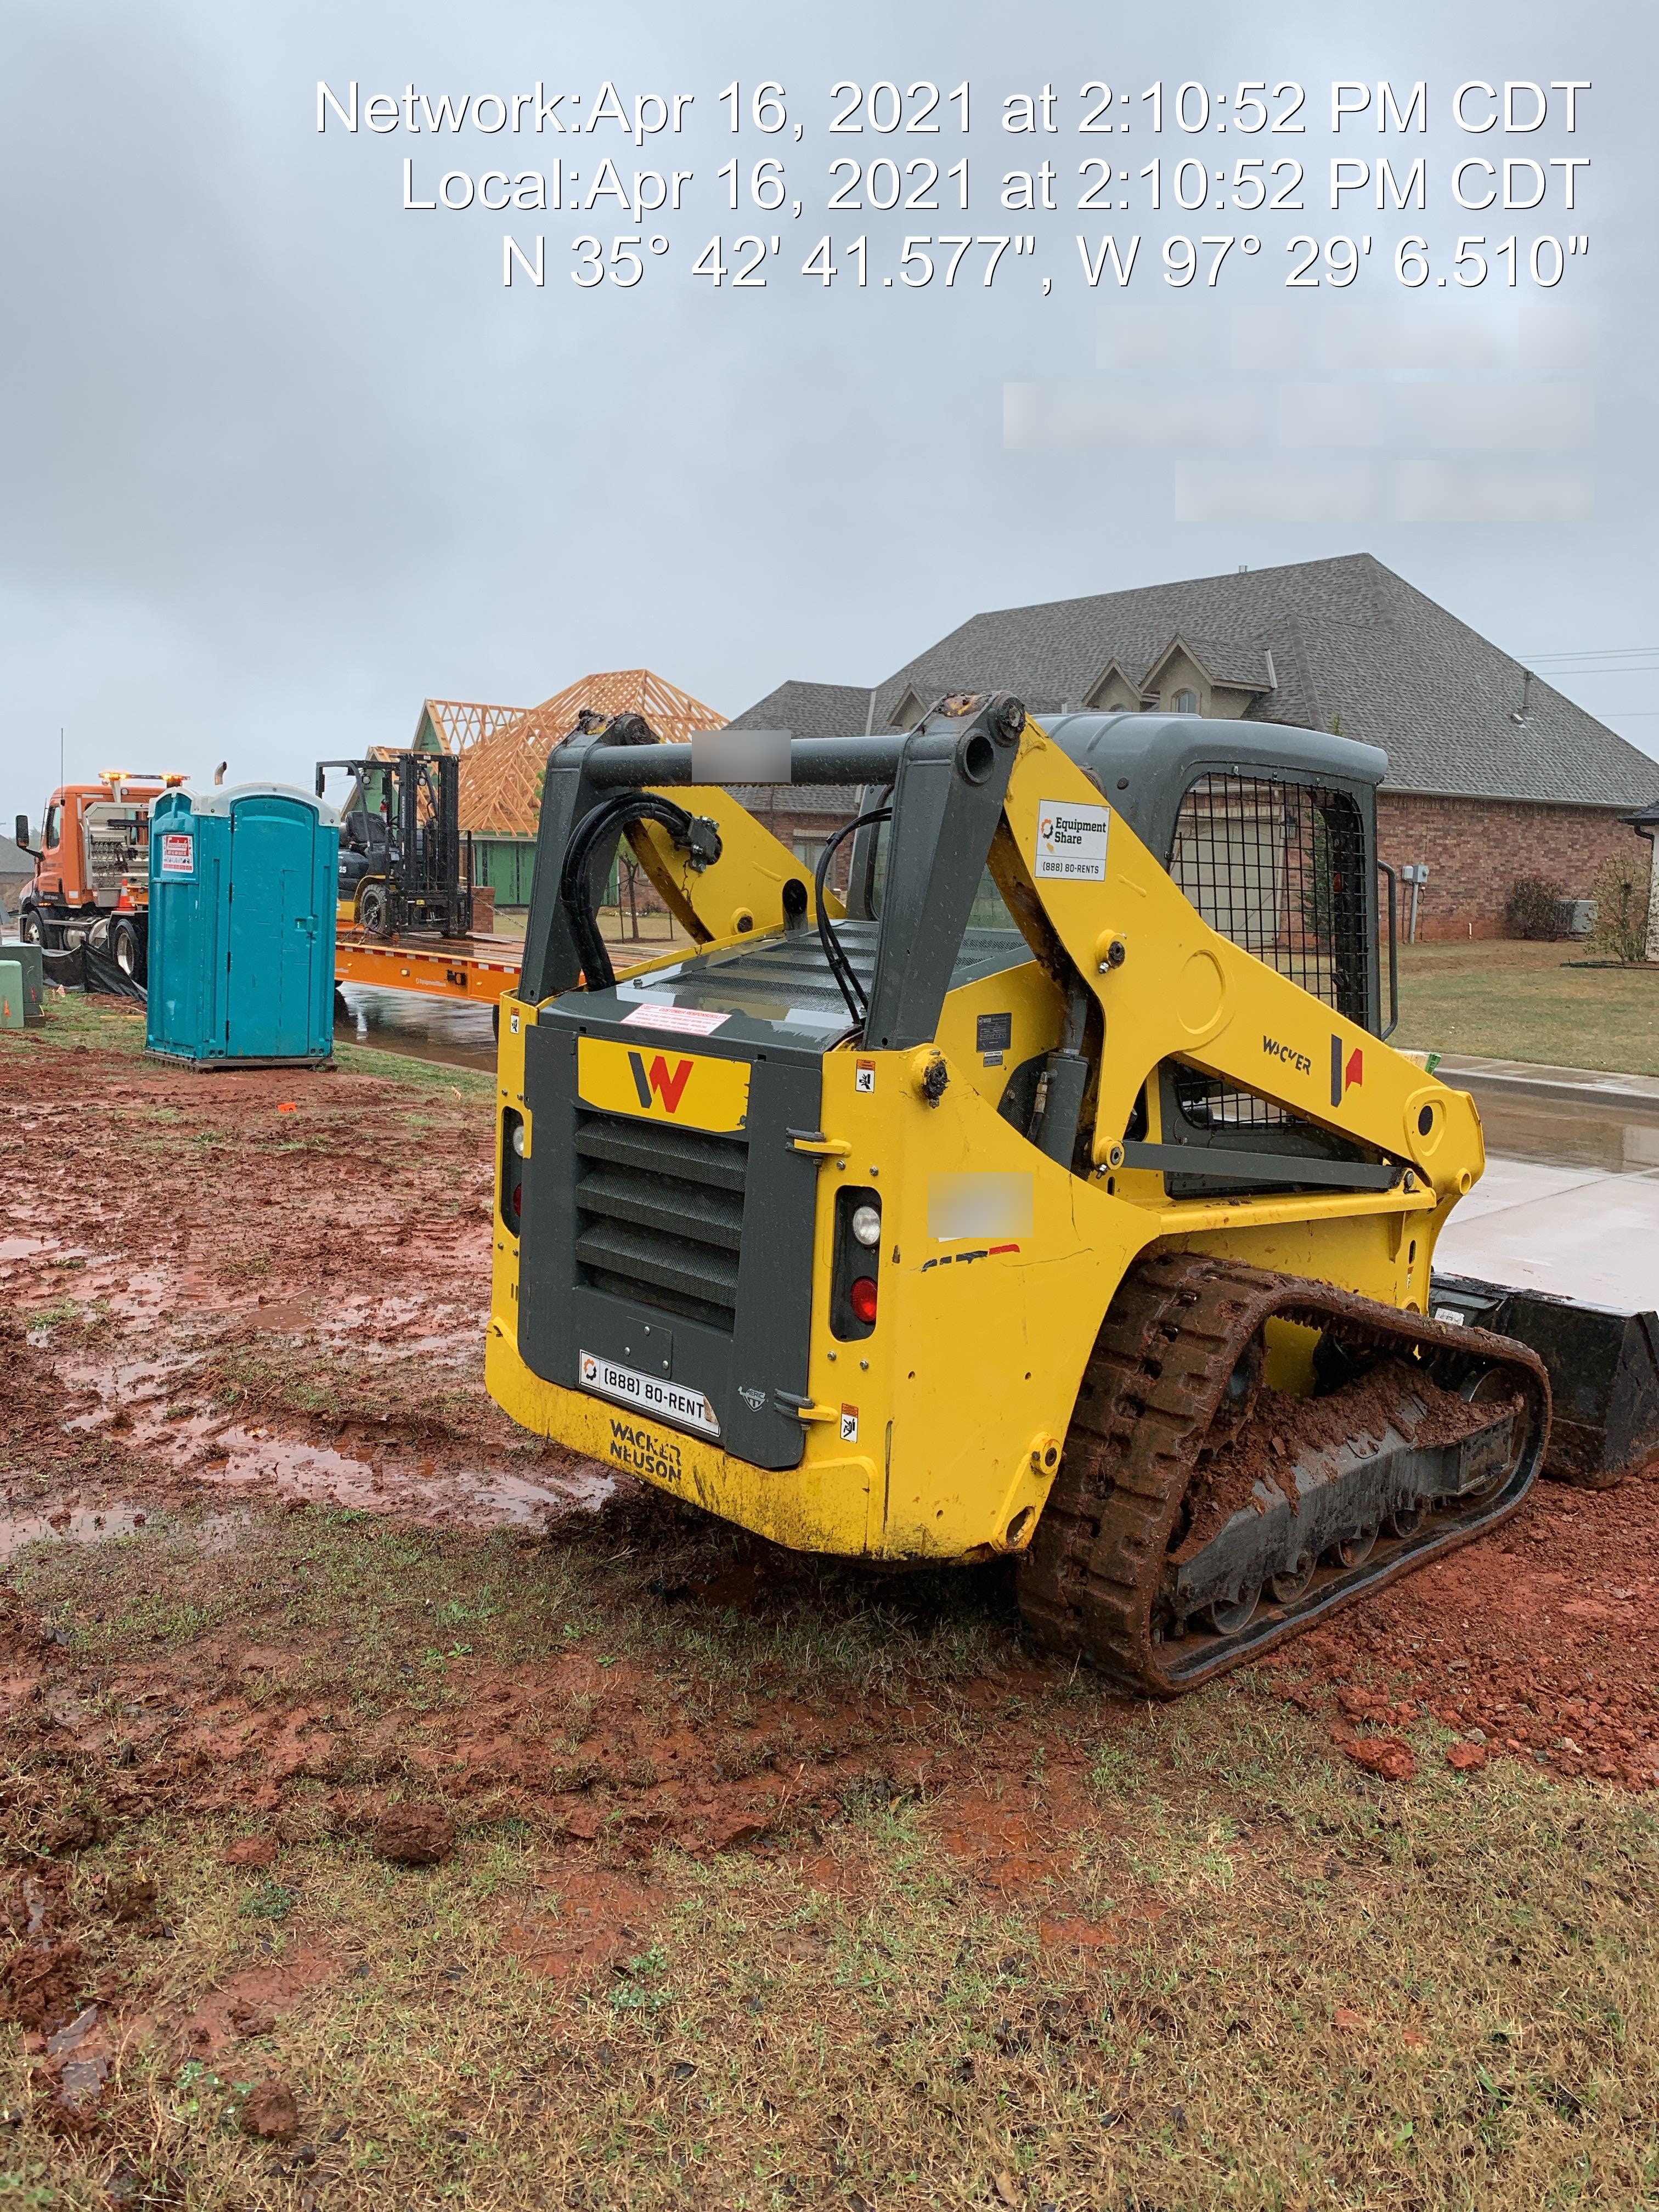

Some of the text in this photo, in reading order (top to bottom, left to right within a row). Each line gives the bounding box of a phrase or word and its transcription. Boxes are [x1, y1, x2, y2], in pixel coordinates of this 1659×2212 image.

[1054, 831, 1082, 844] Share
[1055, 816, 1107, 833] Equipment
[1042, 861, 1099, 874] (888) 80-RENTS
[604, 1367, 704, 1419] (888) 80-RENT
[610, 1418, 682, 1466] WACKER
[610, 1440, 682, 1483] NEUSON
